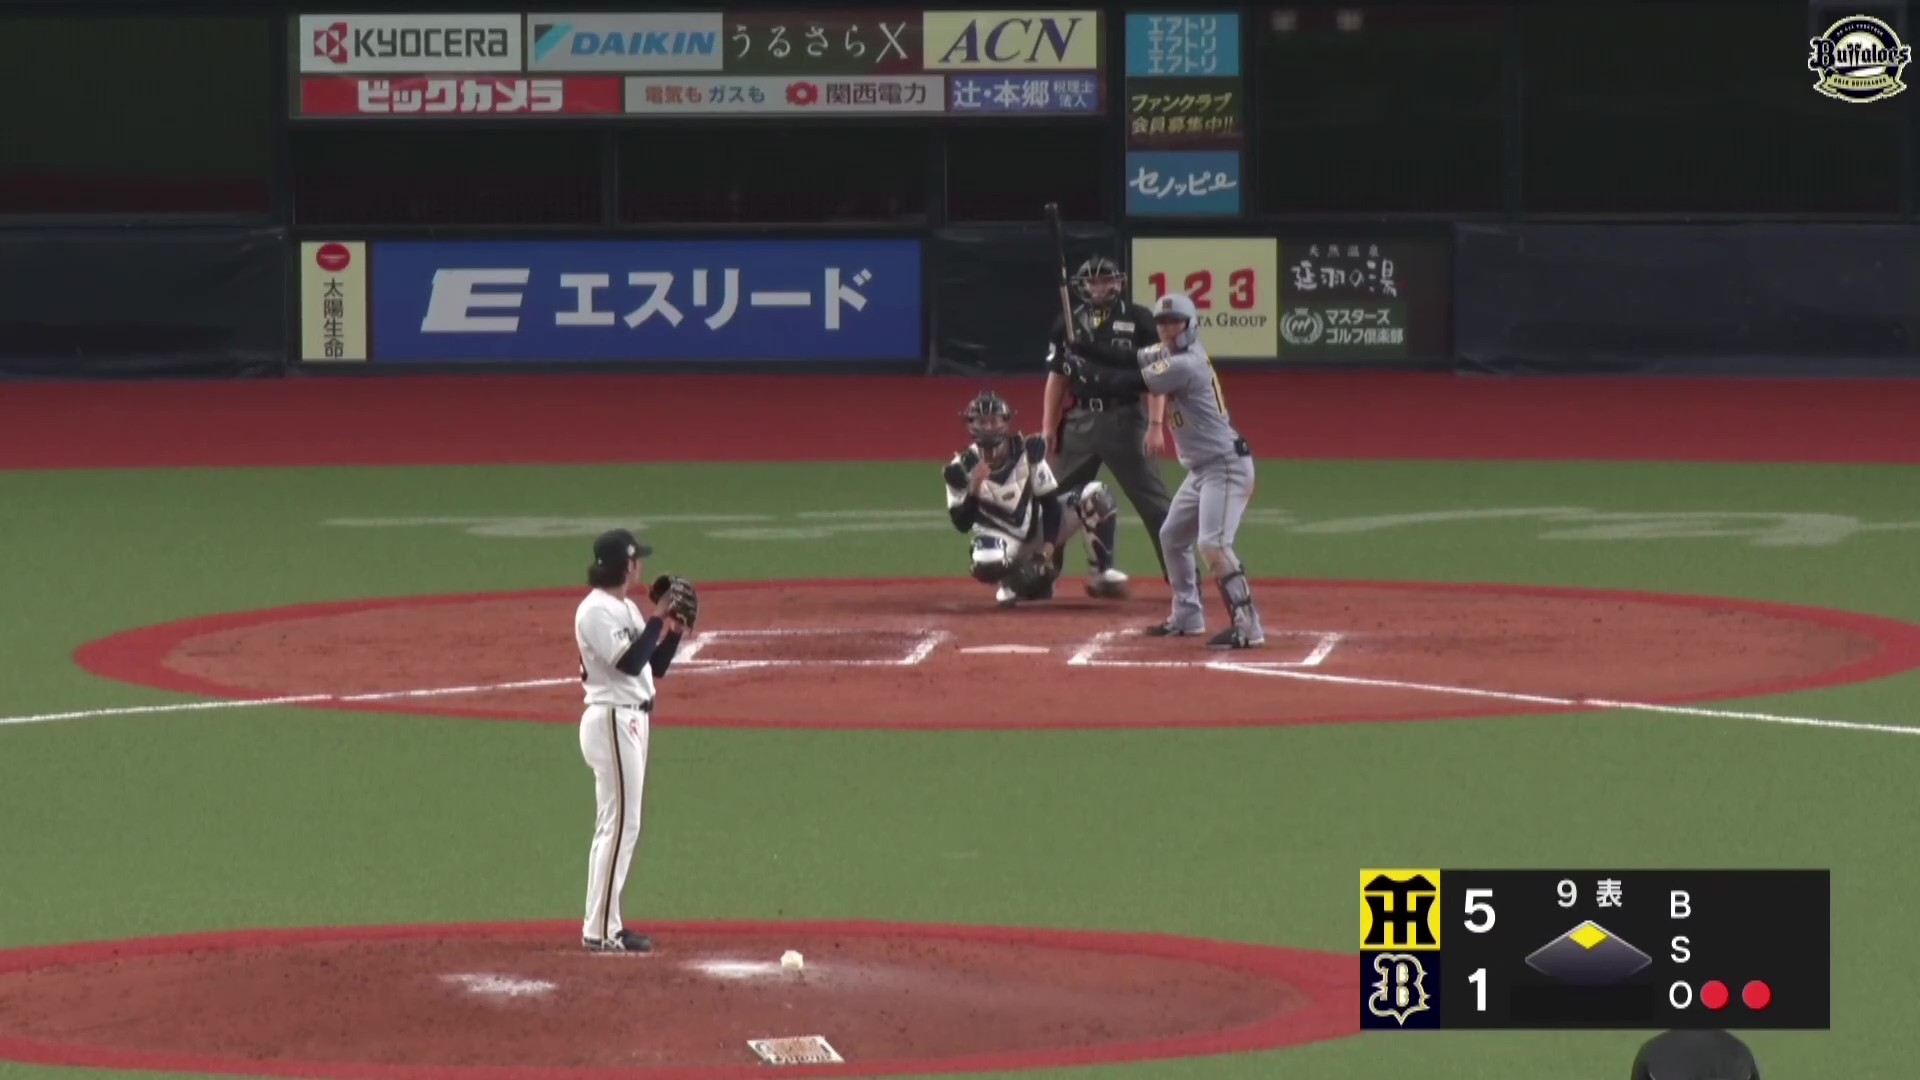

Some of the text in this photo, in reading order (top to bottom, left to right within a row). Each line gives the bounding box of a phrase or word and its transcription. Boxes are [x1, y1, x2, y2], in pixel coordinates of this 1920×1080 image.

[1148, 16, 1217, 35] エアトリ
[354, 28, 508, 58] KYOCERA
[571, 31, 717, 56] DAIKIN
[938, 18, 1082, 63] ACN
[1148, 35, 1217, 54] エアトリ
[1148, 54, 1217, 74] エアトリ
[357, 79, 563, 113] ビックカメラ
[645, 85, 765, 105] 電気も ガスも
[826, 82, 926, 105] 関西電力
[953, 79, 1050, 108] 辻・本郷
[1132, 92, 1232, 113] ファンクラブ
[555, 268, 872, 331] エスリード
[323, 277, 344, 358] 太陽生命
[1325, 308, 1390, 325] マスターズ
